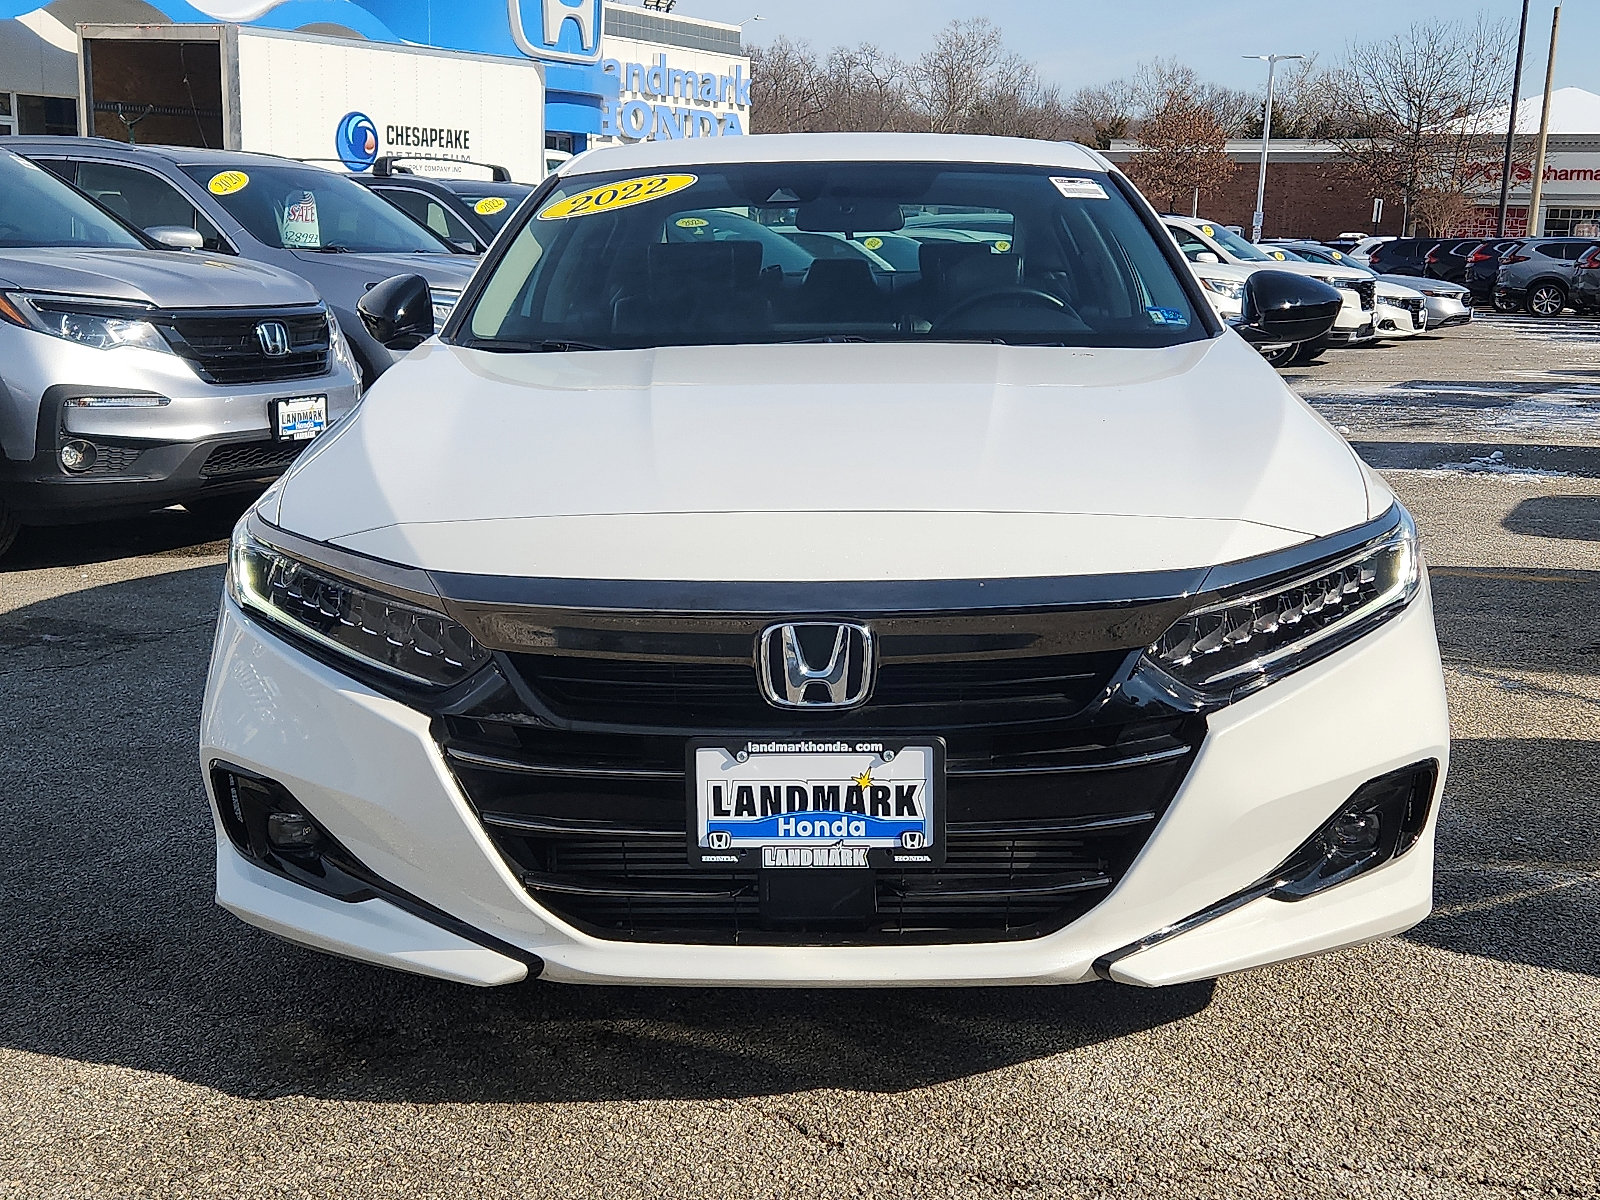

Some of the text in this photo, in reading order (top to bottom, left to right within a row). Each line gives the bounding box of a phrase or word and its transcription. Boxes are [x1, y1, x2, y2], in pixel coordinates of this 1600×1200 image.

[602, 53, 752, 106] andmark
[386, 124, 470, 149] CHESAPEAKE
[566, 177, 670, 215] 2022
[288, 205, 316, 222] SALE
[281, 409, 323, 425] LANDMARK
[856, 742, 883, 752] com
[711, 784, 918, 818] LANDMARK
[777, 817, 866, 838] Honda
[701, 855, 738, 863] HONDA
[764, 848, 867, 867] LANDMARK
